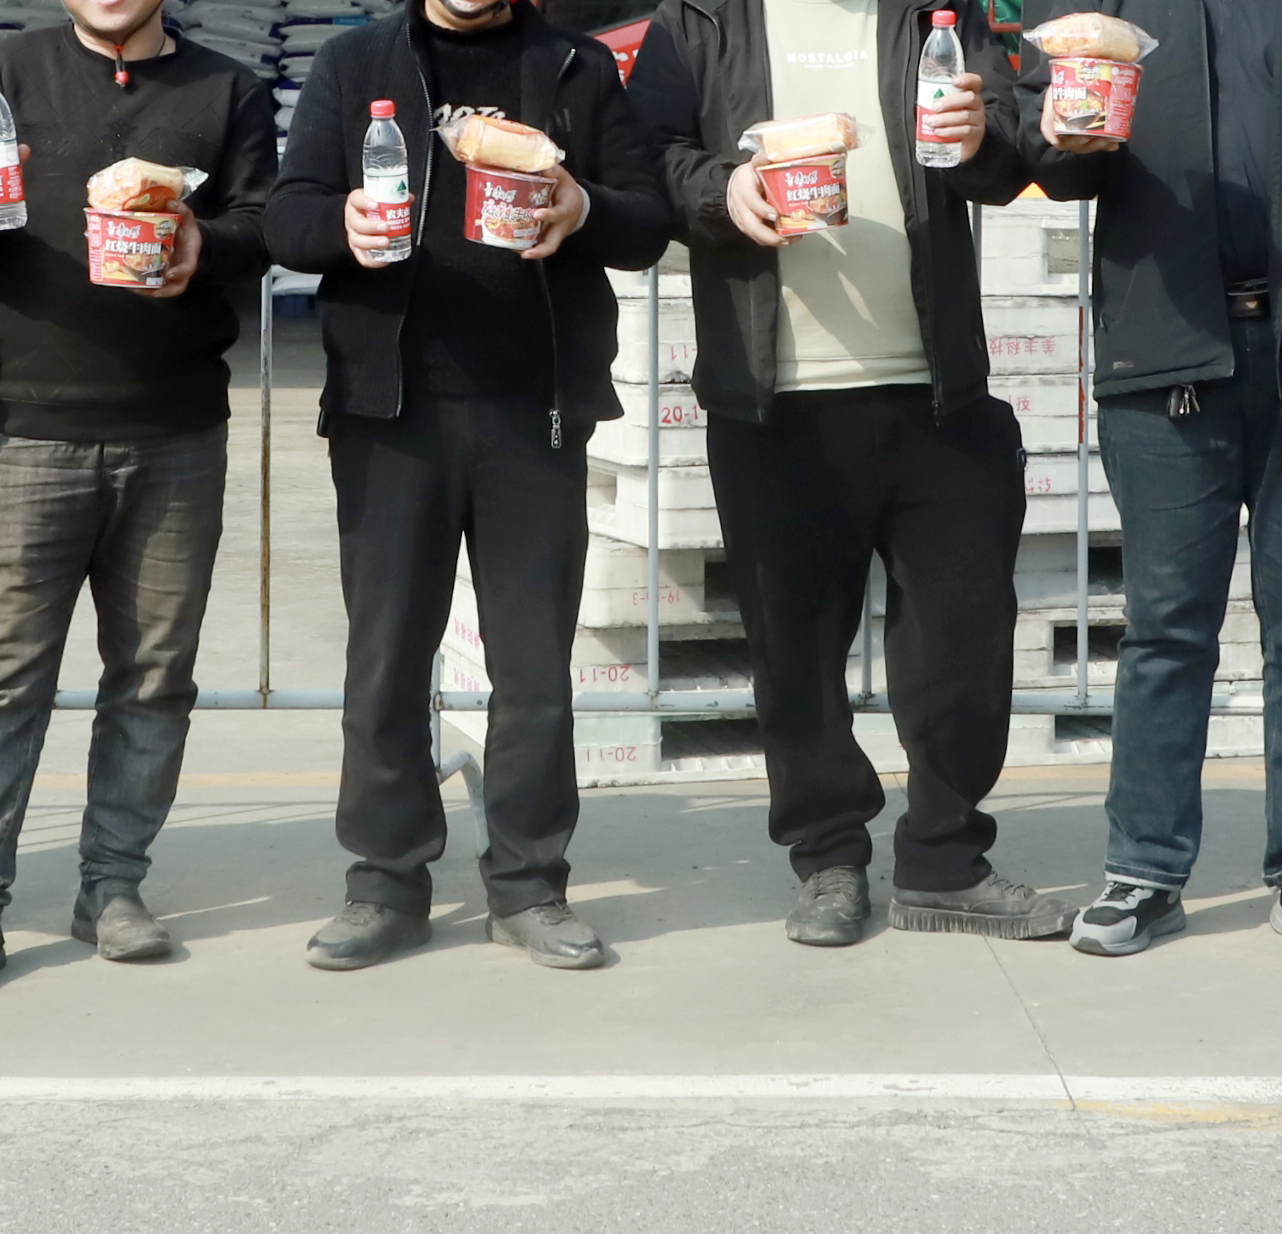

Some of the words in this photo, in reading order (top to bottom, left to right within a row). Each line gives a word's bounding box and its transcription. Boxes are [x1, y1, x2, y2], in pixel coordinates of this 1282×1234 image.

[787, 50, 869, 63] NOSTALGIA
[104, 239, 163, 254] 红烧牛肉面
